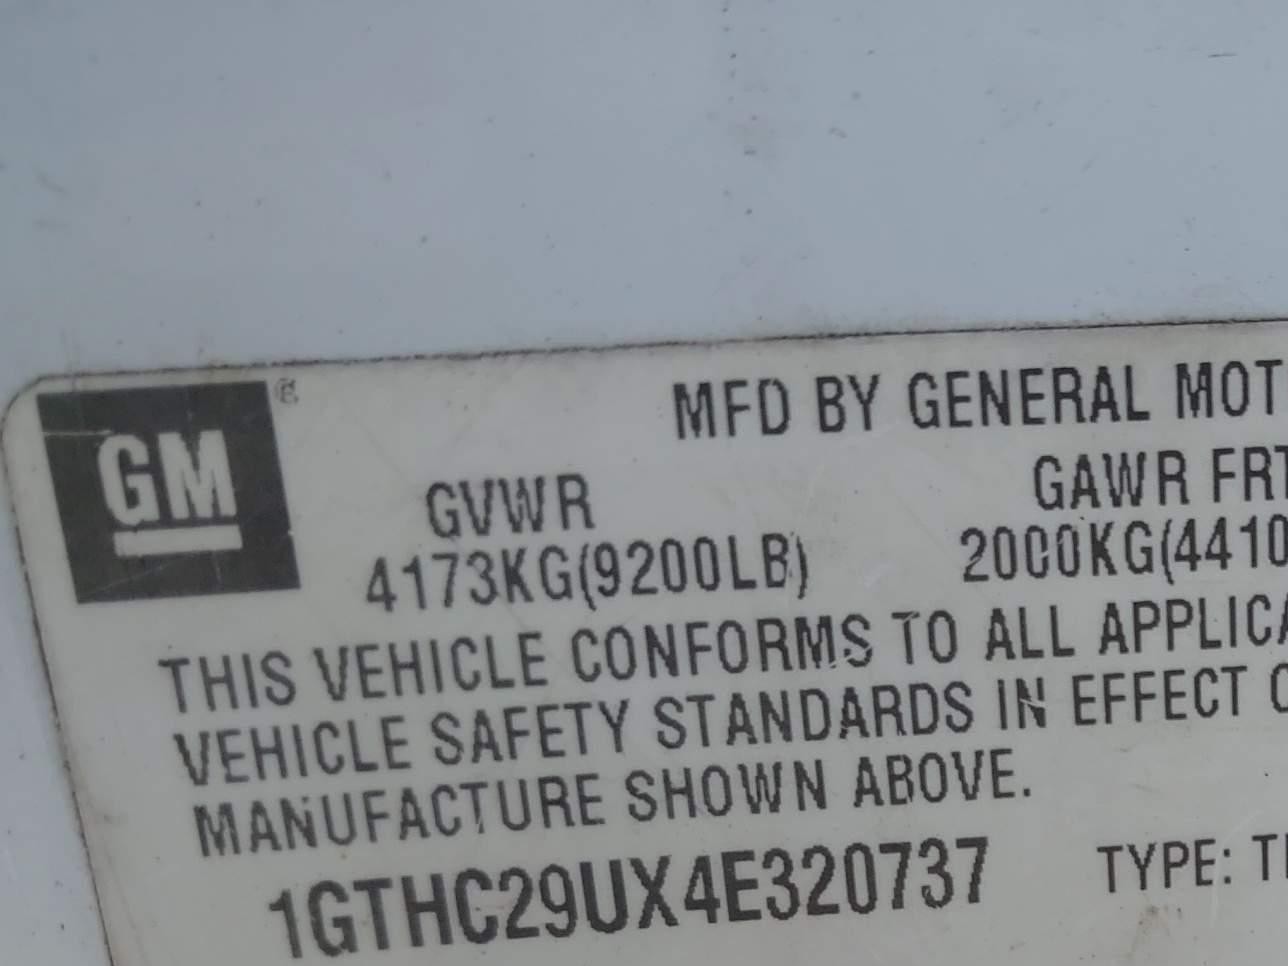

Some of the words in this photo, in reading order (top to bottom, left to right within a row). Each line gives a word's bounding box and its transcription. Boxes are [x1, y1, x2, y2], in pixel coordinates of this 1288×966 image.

[673, 379, 790, 439] MFD
[816, 375, 880, 433] BY
[908, 365, 1150, 429] GENERAL
[96, 429, 238, 526] GM
[425, 474, 594, 538] GVWR
[1034, 450, 1189, 510] GAWR
[366, 533, 808, 611] 4173KG(9200LB)
[158, 651, 295, 713] THIS
[314, 632, 547, 701] VEHICLE
[572, 614, 872, 682] CONFORMS
[892, 610, 957, 664] TO
[986, 605, 1074, 660] ALL
[173, 716, 410, 785] VEHICLE
[431, 700, 627, 765] SAFETY
[654, 682, 973, 749] STANDARDS
[998, 678, 1046, 730] IN
[1072, 666, 1247, 726] EFFECT
[194, 774, 604, 857] MANUFACTURE
[625, 760, 826, 821] SHOWN
[854, 749, 1030, 807] ABOVE.
[269, 837, 988, 958] 1GTHC29UX4E320737
[1097, 838, 1231, 893] TYPE:
